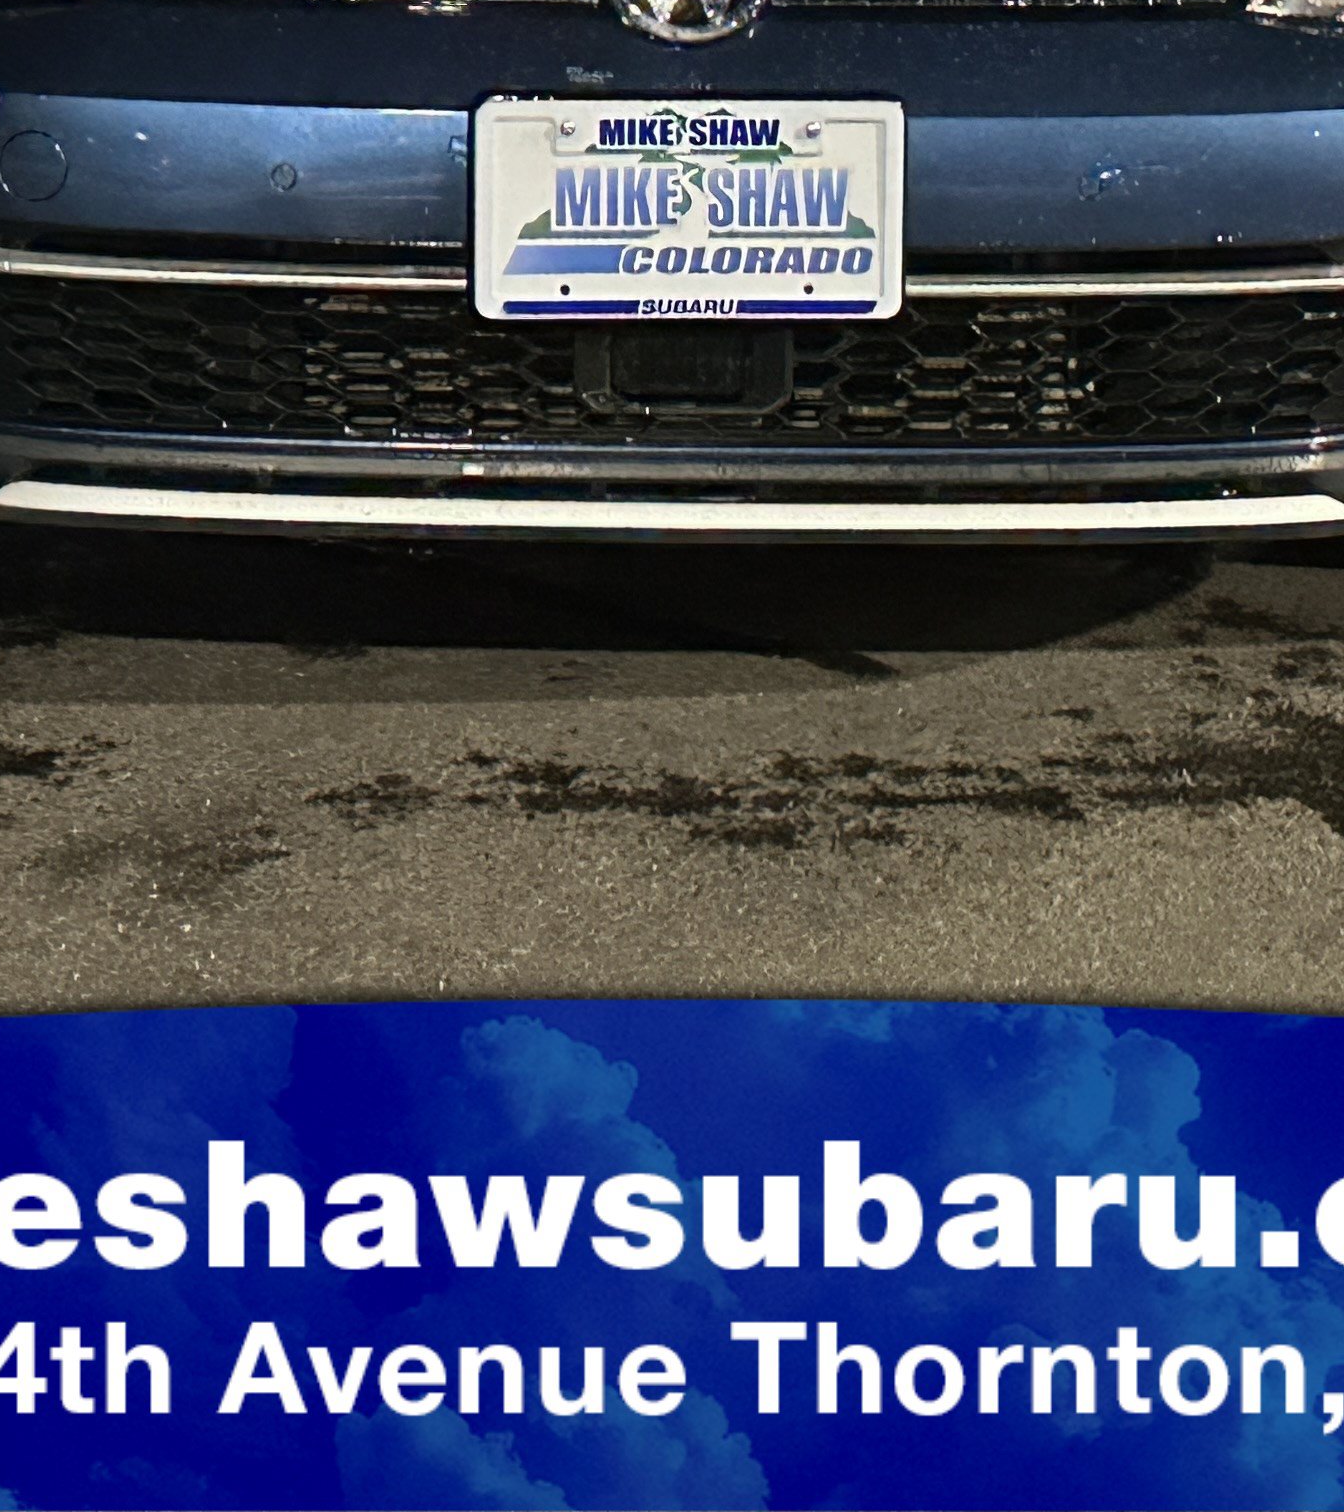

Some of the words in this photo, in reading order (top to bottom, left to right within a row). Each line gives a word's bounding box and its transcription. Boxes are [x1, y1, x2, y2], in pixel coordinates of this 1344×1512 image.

[599, 118, 678, 147] MIKE
[689, 118, 780, 147] SHAW
[556, 168, 679, 227] MIKE
[708, 168, 848, 227] SHAW
[621, 245, 874, 275] COLORADO
